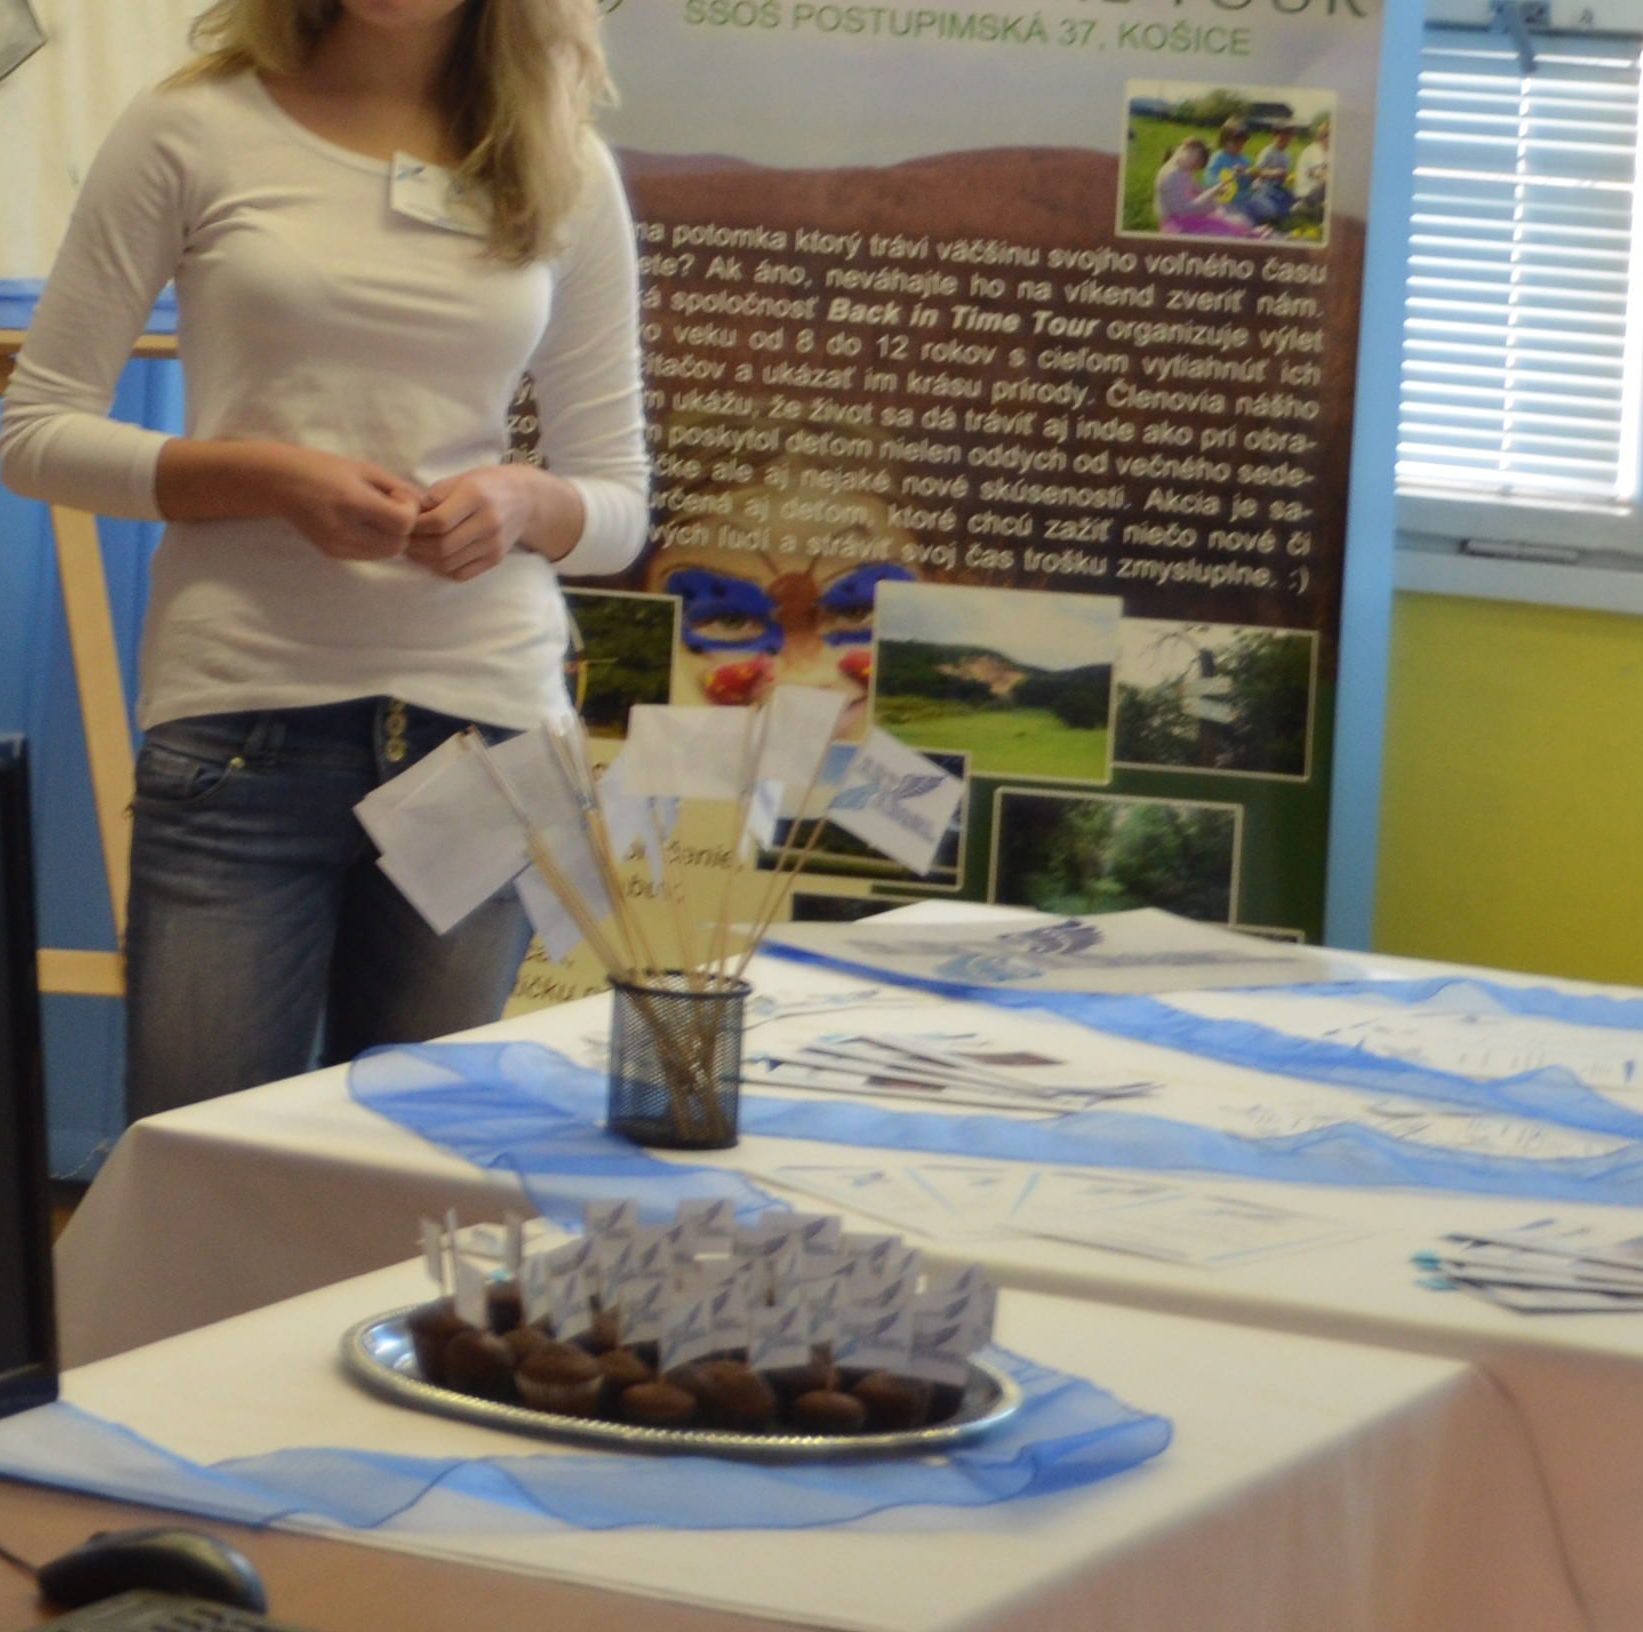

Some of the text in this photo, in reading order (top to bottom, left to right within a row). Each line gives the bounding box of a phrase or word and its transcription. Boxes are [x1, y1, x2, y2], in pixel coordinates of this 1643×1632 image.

[794, 2, 1048, 44] POSTUPIMSKÁ
[1059, 18, 1106, 52] 37,
[1118, 18, 1253, 57] KOŠICE
[672, 225, 787, 250] potomka
[795, 227, 862, 260] ktorý
[1048, 246, 1137, 275] svojho
[1262, 256, 1328, 285] času
[705, 256, 742, 281] Ak
[753, 259, 812, 289] áno,
[825, 265, 958, 299] neváhajte
[970, 272, 1006, 299] ho
[1017, 279, 1052, 302] na
[1256, 292, 1324, 319] nám.
[670, 288, 820, 319] spoločnosť
[827, 297, 901, 326] Back
[910, 302, 939, 328] in
[951, 304, 1021, 334] Time
[1031, 309, 1101, 339] Tour
[1106, 318, 1250, 350] organizuje
[1259, 324, 1325, 355] výlet
[673, 322, 738, 348] veku
[749, 327, 785, 351] od
[795, 328, 815, 353] 8
[826, 331, 863, 357] do
[875, 334, 909, 360] 12
[921, 336, 997, 366] rokov
[1008, 346, 1026, 367] s
[1280, 361, 1321, 387] ich
[734, 362, 753, 383] a
[864, 366, 898, 393] im
[907, 369, 983, 398] krásu
[1106, 378, 1226, 415] Členovia
[668, 424, 779, 453] poskytol
[879, 437, 961, 465] nielen
[968, 443, 1067, 474] oddych
[1073, 450, 1109, 474] od
[880, 404, 914, 428] sa
[921, 404, 957, 431] dá
[1042, 417, 1068, 444] aj
[1076, 416, 1136, 442] inde
[1142, 421, 1194, 447] ako
[711, 458, 754, 483] ale
[902, 473, 969, 500] nové
[1143, 487, 1221, 517] Akcia
[887, 502, 957, 532] ktoré
[967, 510, 1033, 538] chcú
[1207, 529, 1276, 555] nové
